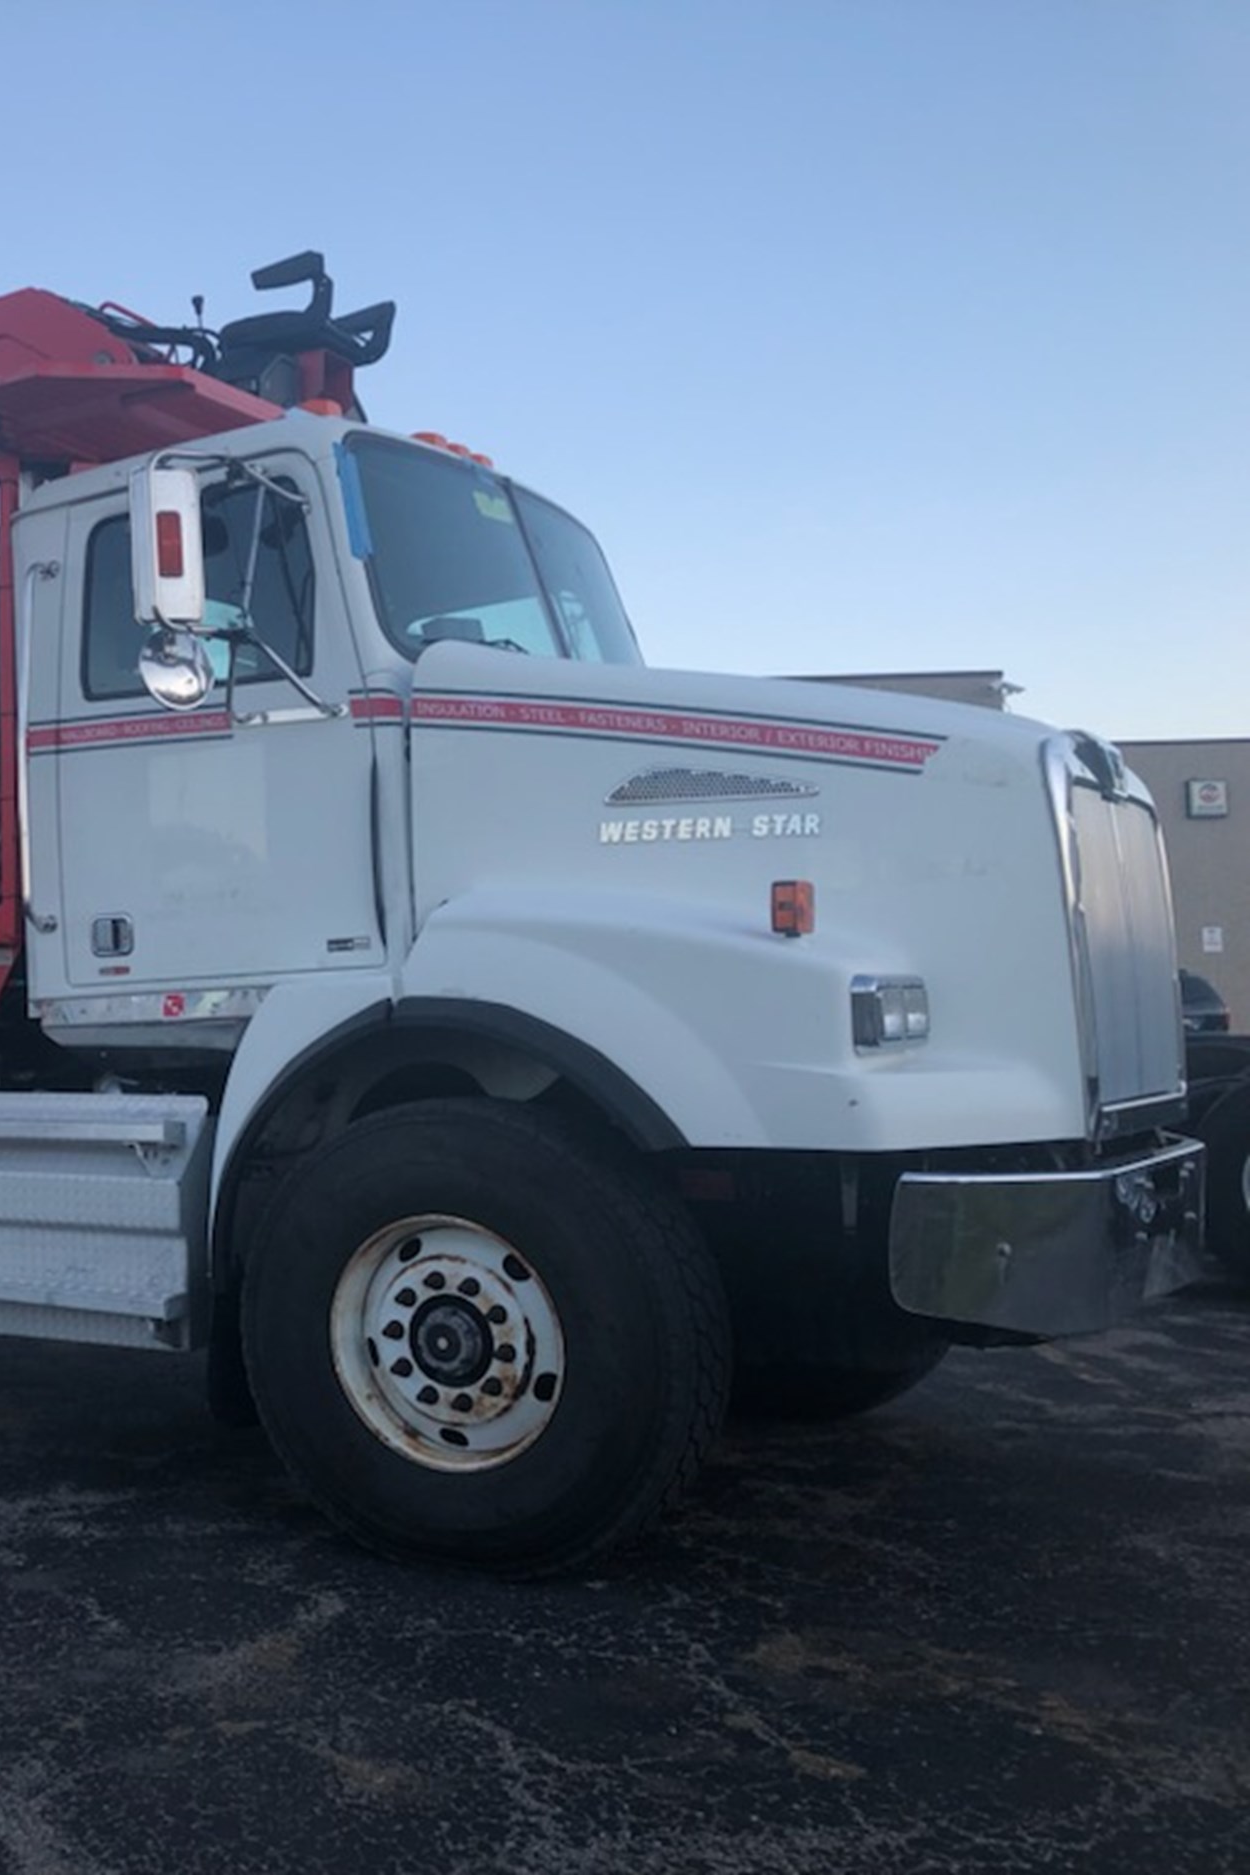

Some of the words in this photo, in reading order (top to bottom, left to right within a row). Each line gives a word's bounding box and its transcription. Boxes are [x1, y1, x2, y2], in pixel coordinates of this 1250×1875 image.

[416, 700, 507, 720] INSULATION
[519, 708, 566, 724] STEEL
[578, 711, 668, 732] FASTENERS
[681, 719, 762, 743] INTERIOR
[776, 729, 861, 752] EXTERIOR
[599, 815, 733, 844] WESTERN
[751, 813, 820, 838] STAR
